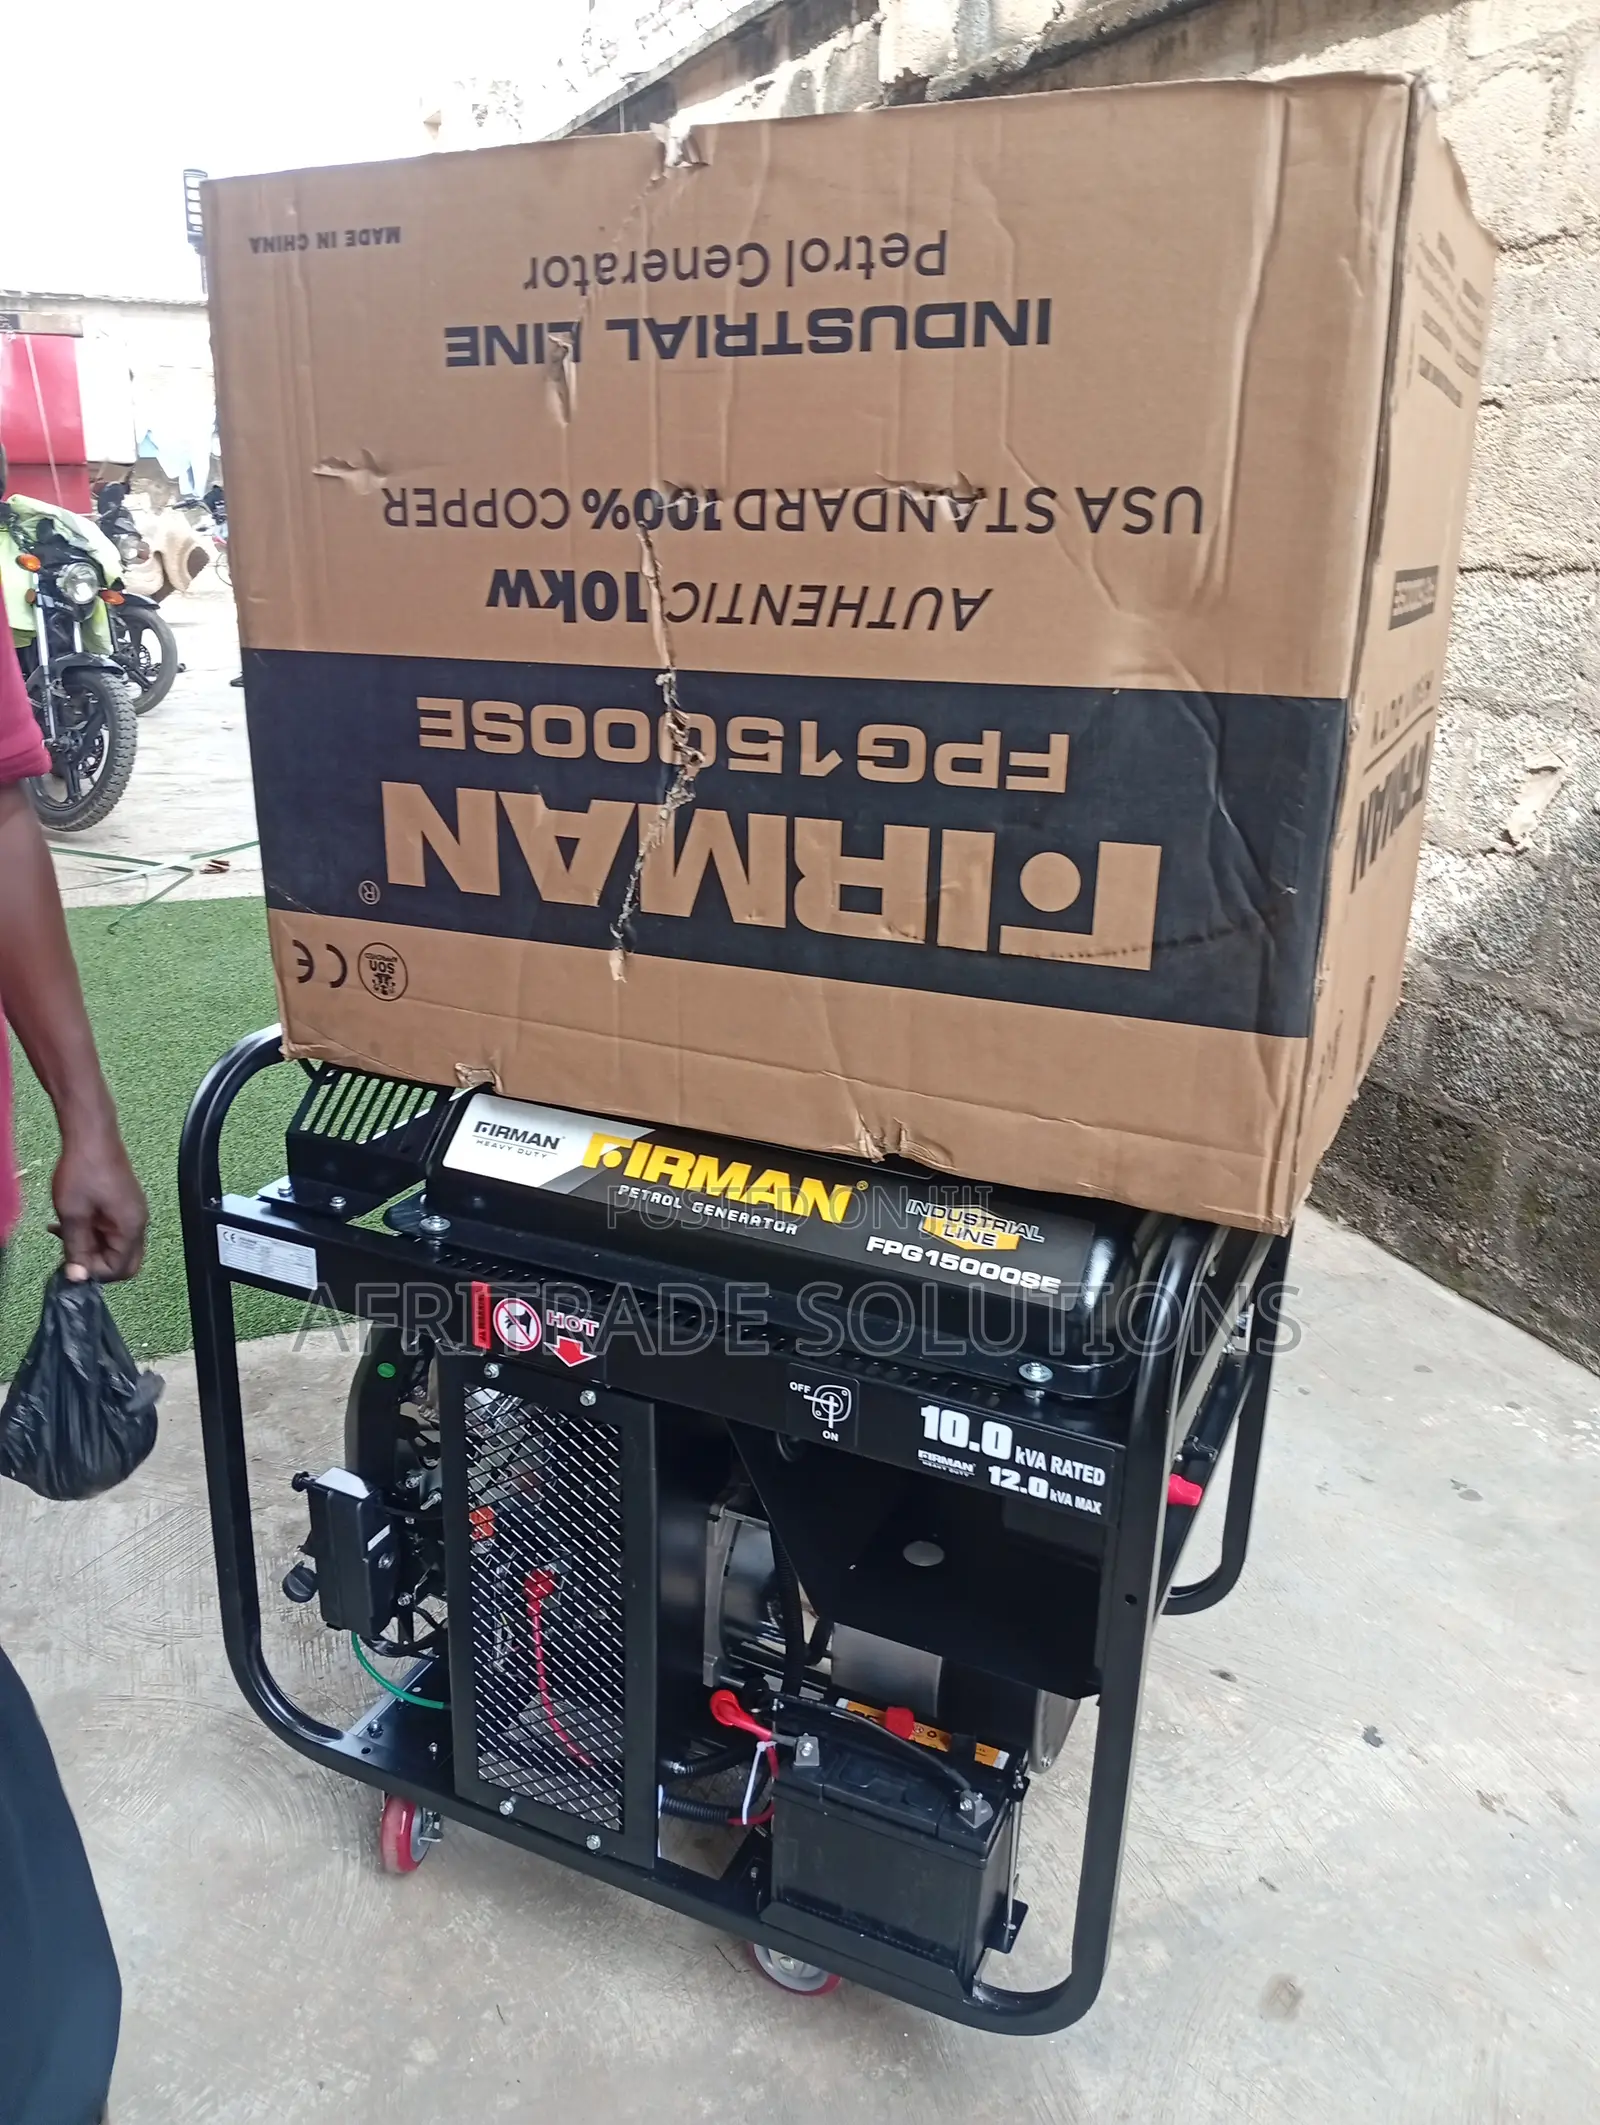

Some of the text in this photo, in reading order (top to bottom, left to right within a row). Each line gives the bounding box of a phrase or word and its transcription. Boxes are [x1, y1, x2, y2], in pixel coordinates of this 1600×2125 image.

[249, 225, 401, 253] MADE IN CHINA
[522, 228, 949, 297] Petrol Generator
[443, 297, 1052, 366] INDUSTRIAL LINE
[382, 484, 1203, 535] USA STANDARD 100% COPPER
[485, 567, 991, 630] AUTHENTIC 10kw
[415, 695, 1069, 793] FPG15000SE
[380, 781, 1162, 970] FIRMAN
[473, 1121, 560, 1149] FIRMAN
[476, 1139, 549, 1159] HEAVY DUTY
[582, 1132, 855, 1224] FIRMAN
[618, 1185, 798, 1235] PETROL GENERATOR
[906, 1199, 1045, 1243] INDUSTRIAL
[943, 1224, 996, 1246] LINE
[866, 1235, 1061, 1294] FPG15000SE
[546, 1310, 599, 1337] HOT
[789, 1382, 811, 1394] OFF
[822, 1429, 839, 1442] ON
[920, 1405, 1106, 1486] 10.0 kVA RATED
[918, 1449, 973, 1473] FIRMAN
[988, 1465, 1103, 1515] 12.0 kVA MAX
